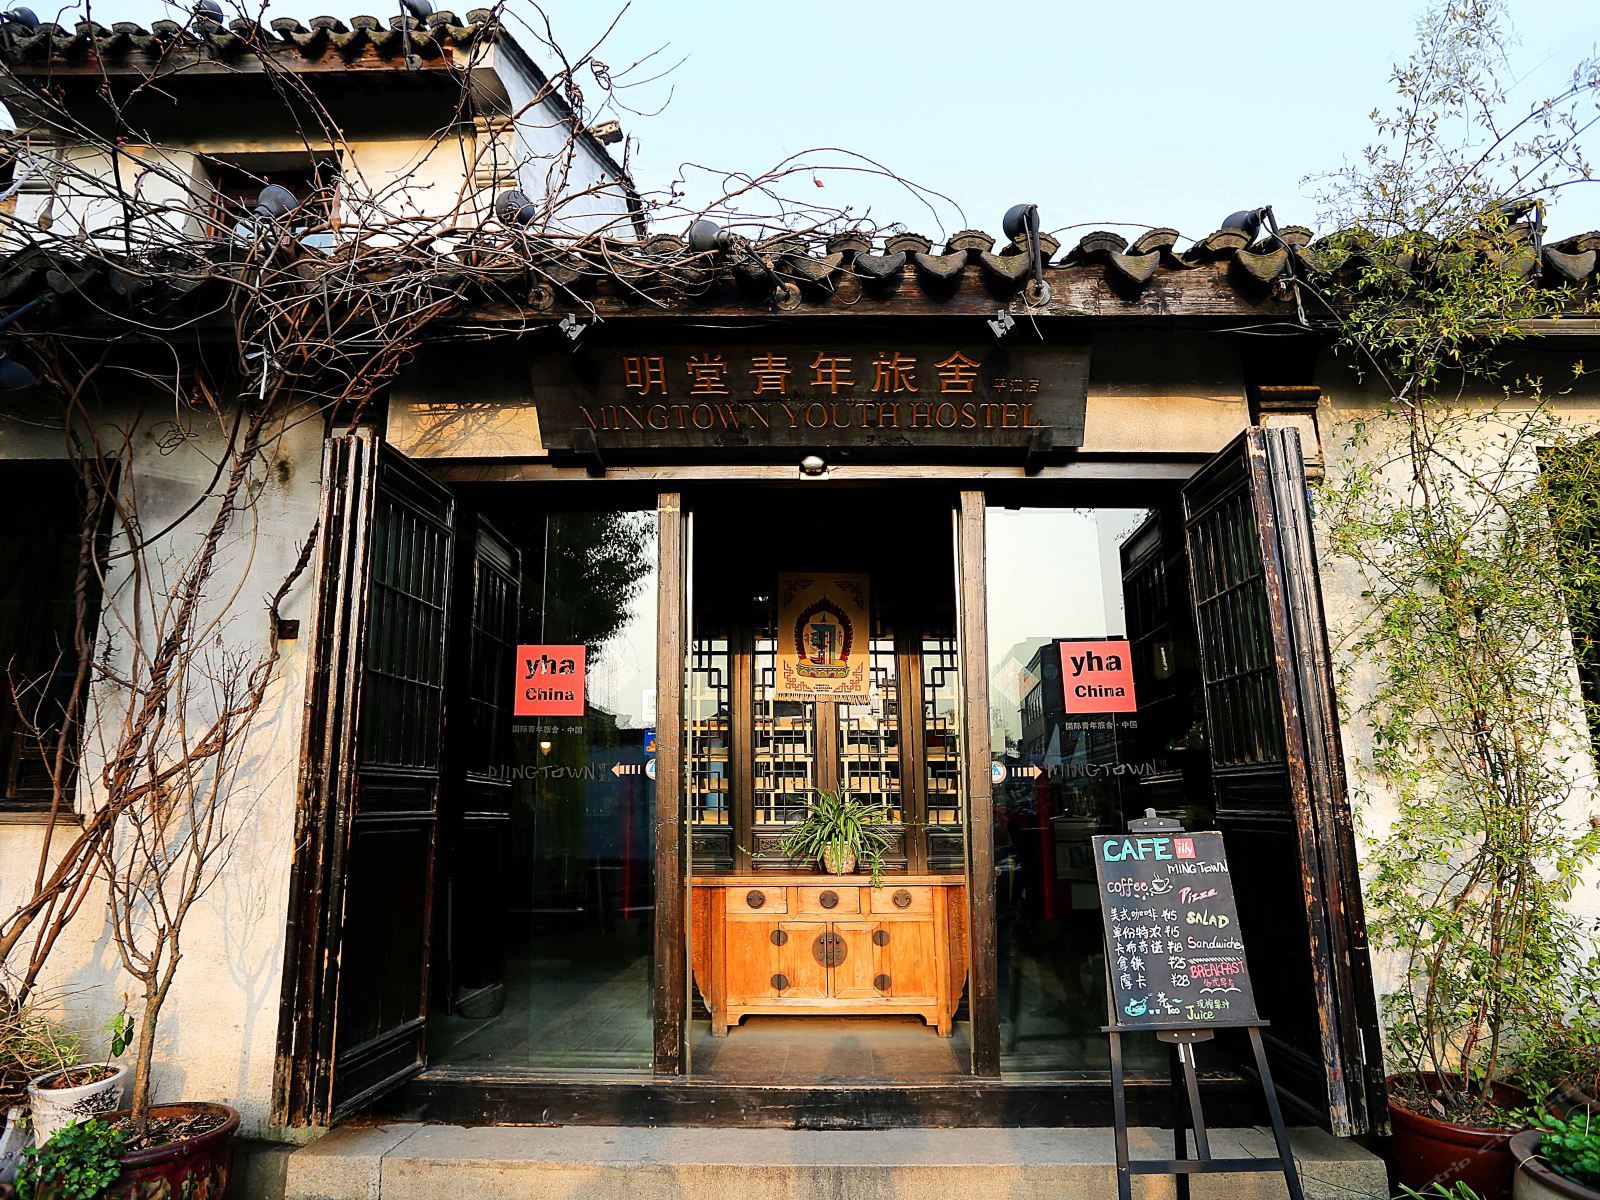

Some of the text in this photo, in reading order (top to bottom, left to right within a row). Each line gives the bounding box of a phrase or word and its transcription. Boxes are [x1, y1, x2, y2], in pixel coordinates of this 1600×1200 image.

[621, 350, 983, 395] 明堂青年旅舍
[578, 402, 1042, 431] MINGTOWN YOUTH HOSTEL
[525, 654, 575, 680] yha
[1070, 650, 1122, 677] yha
[525, 687, 575, 701] China
[1075, 684, 1125, 698] China
[1103, 837, 1194, 862] CAFE illy
[1107, 877, 1149, 897] coffee
[1110, 906, 1158, 922] 美式咖啡
[1186, 908, 1230, 929] SALAD
[1112, 923, 1163, 942] 单份特浓
[1114, 939, 1164, 957] 卡布奇诺
[1189, 960, 1245, 979] BREAKFAST
[1120, 972, 1148, 991] 摩卡
[1185, 1005, 1215, 1020] Juice
